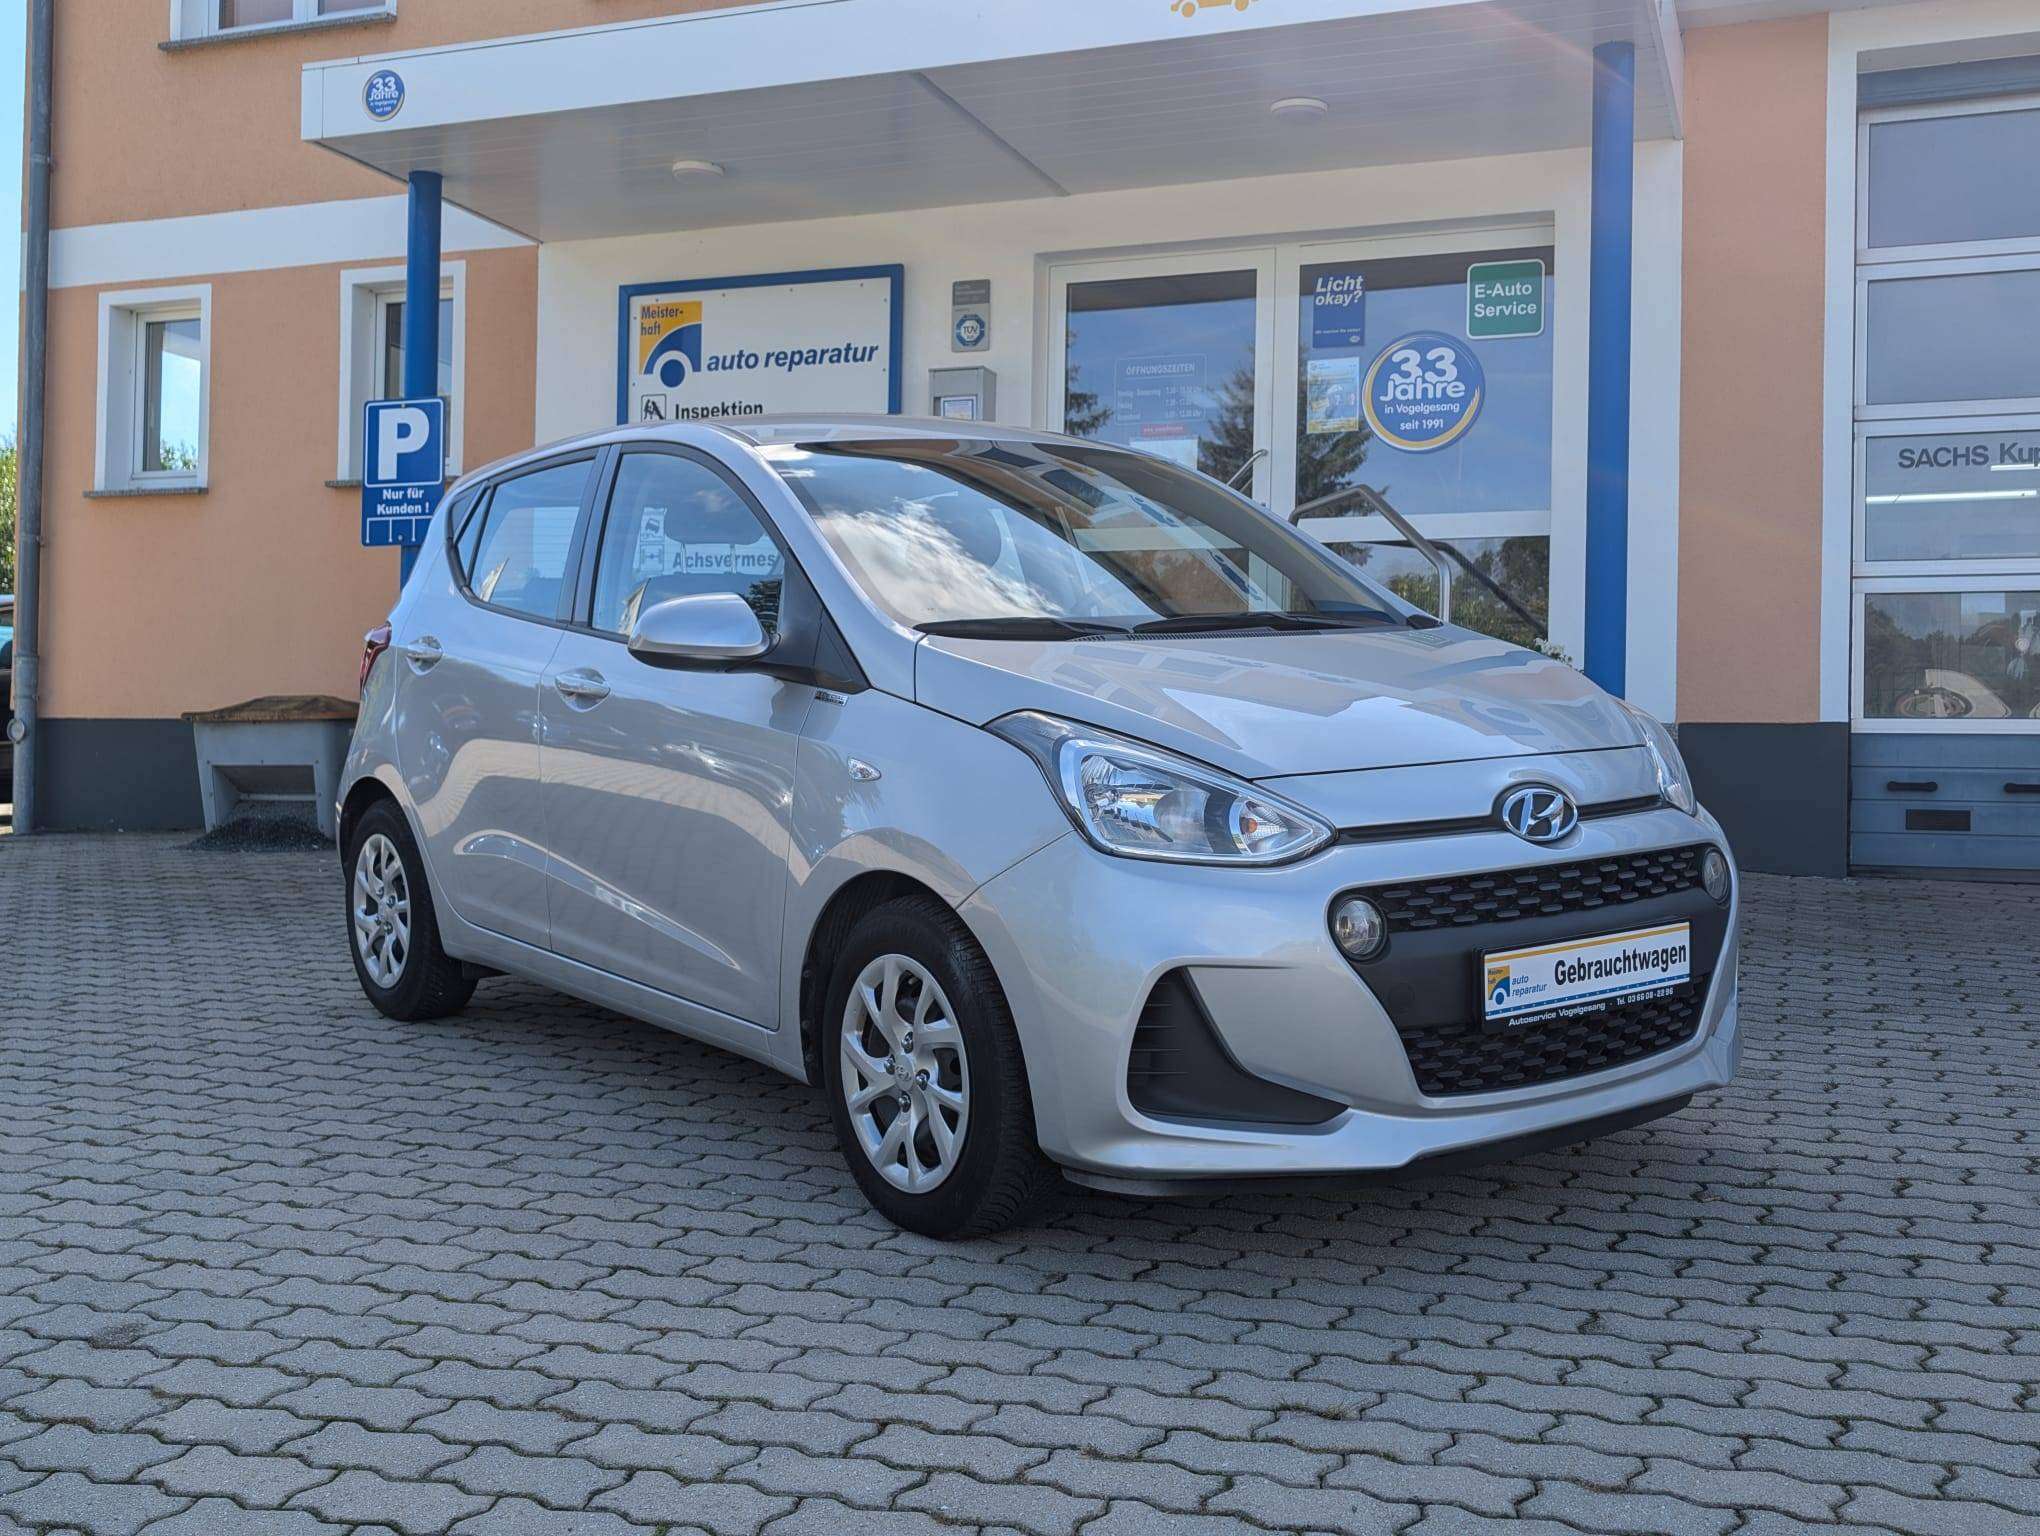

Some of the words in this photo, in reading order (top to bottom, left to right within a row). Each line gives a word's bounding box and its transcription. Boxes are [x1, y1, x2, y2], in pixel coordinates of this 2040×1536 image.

[372, 76, 396, 91] 33
[1315, 275, 1364, 292] Licht
[1474, 282, 1532, 298] E-Auto
[1315, 290, 1363, 307] okay?
[641, 305, 684, 321] Meister-
[1474, 301, 1537, 318] Service
[640, 322, 661, 336] haft
[707, 350, 759, 372] auto
[764, 342, 879, 372] reparatur
[1390, 347, 1458, 383] 33
[1379, 377, 1466, 402] Jahre
[675, 401, 763, 420] Inspektion
[1384, 404, 1394, 414] in
[1396, 401, 1460, 415] Vogelgesang
[1400, 421, 1419, 430] seit
[1422, 419, 1444, 429] 1991
[378, 407, 430, 480] P
[1897, 444, 1989, 469] SACHS
[382, 489, 403, 500] Nur
[406, 489, 424, 499] für
[376, 503, 422, 515] Kunden
[1554, 944, 1687, 986] Gebrauchtwagen
[1511, 975, 1529, 985] auto
[1511, 984, 1548, 997] reparatur
[1508, 1010, 1557, 1027] Autoservice
[1558, 1002, 1606, 1018] Vogelgesang
